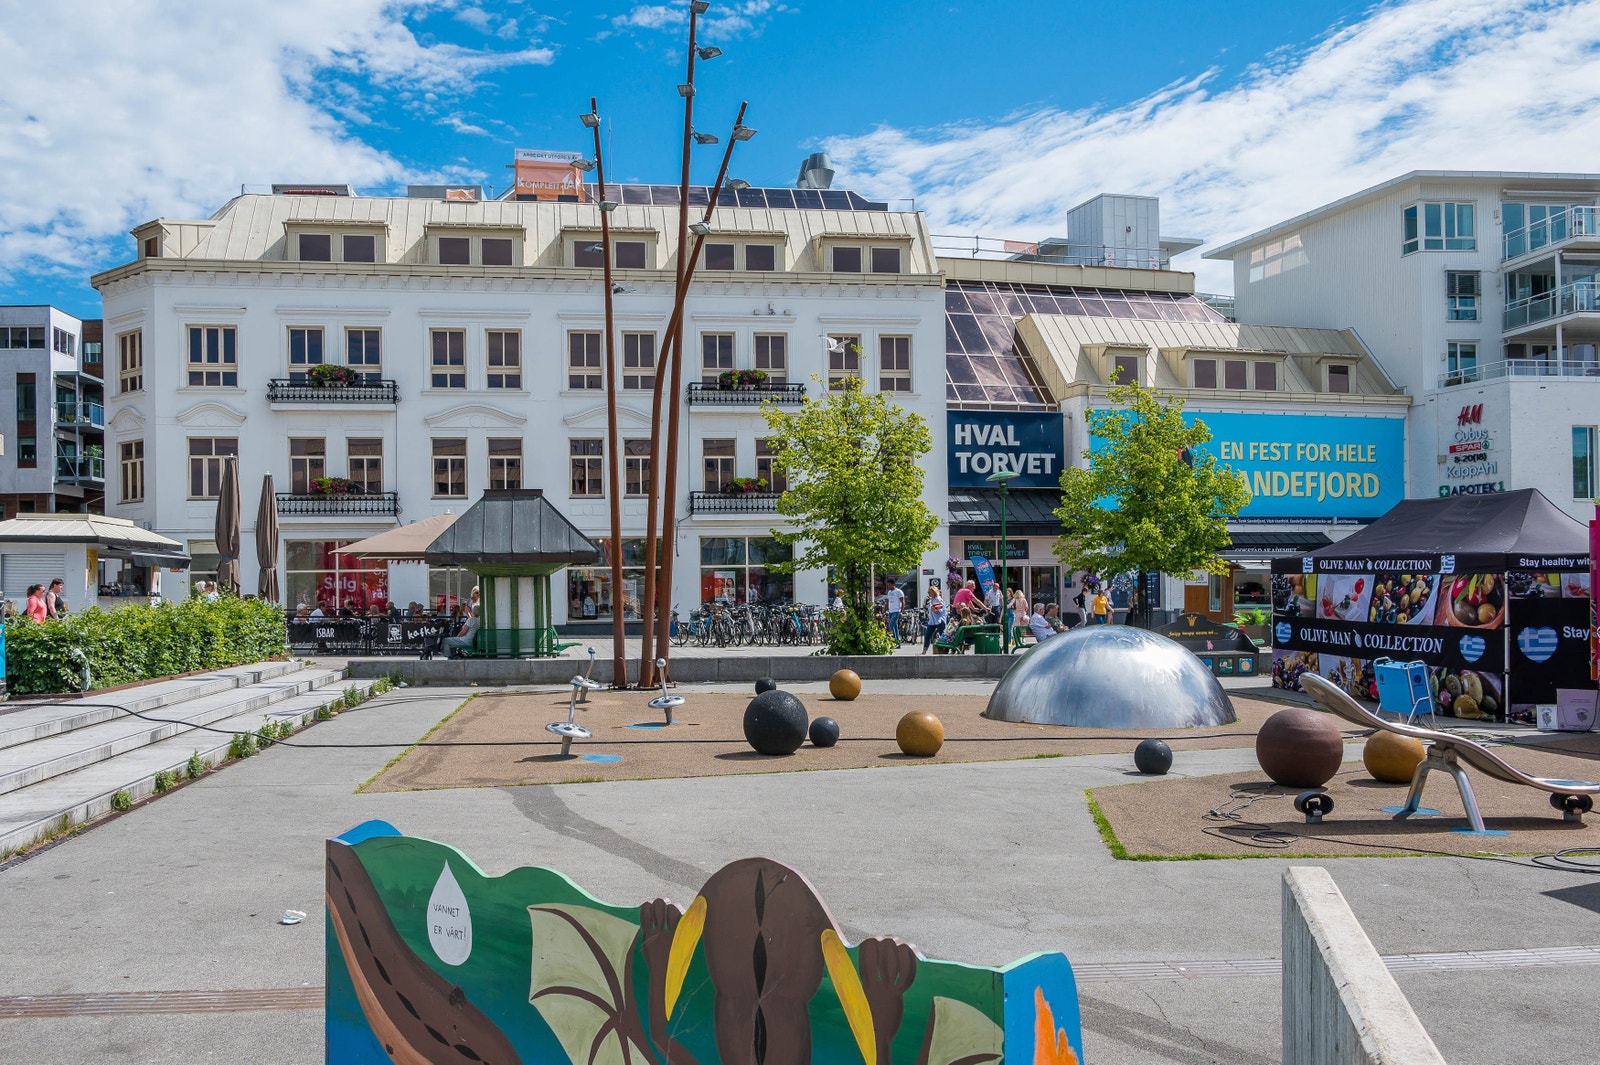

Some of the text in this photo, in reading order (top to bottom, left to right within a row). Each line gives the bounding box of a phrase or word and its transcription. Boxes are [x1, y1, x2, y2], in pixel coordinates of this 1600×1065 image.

[1457, 403, 1484, 427] H&M
[954, 423, 1021, 446] HVAL
[1454, 427, 1489, 443] Cubus
[1220, 441, 1377, 463] EN FEST FOR HELE
[1455, 443, 1482, 452] SPAR
[954, 451, 1056, 474] TORVET
[1446, 461, 1498, 480] KappAhl
[1240, 470, 1380, 503] ANDEFJORD
[1451, 481, 1505, 497] APOTEK 1
[1319, 559, 1432, 571] OLIVE MAN COLLECTION
[1519, 556, 1590, 568] Stay healthy wit
[324, 576, 356, 592] Salg
[316, 627, 335, 638] ISBAR
[407, 626, 438, 640] kafka
[1563, 625, 1590, 640] Stay
[1300, 628, 1444, 654] OLIVE MAN COLLECTION
[433, 903, 460, 918] VANNET
[434, 925, 467, 942] ER VÅRT!
